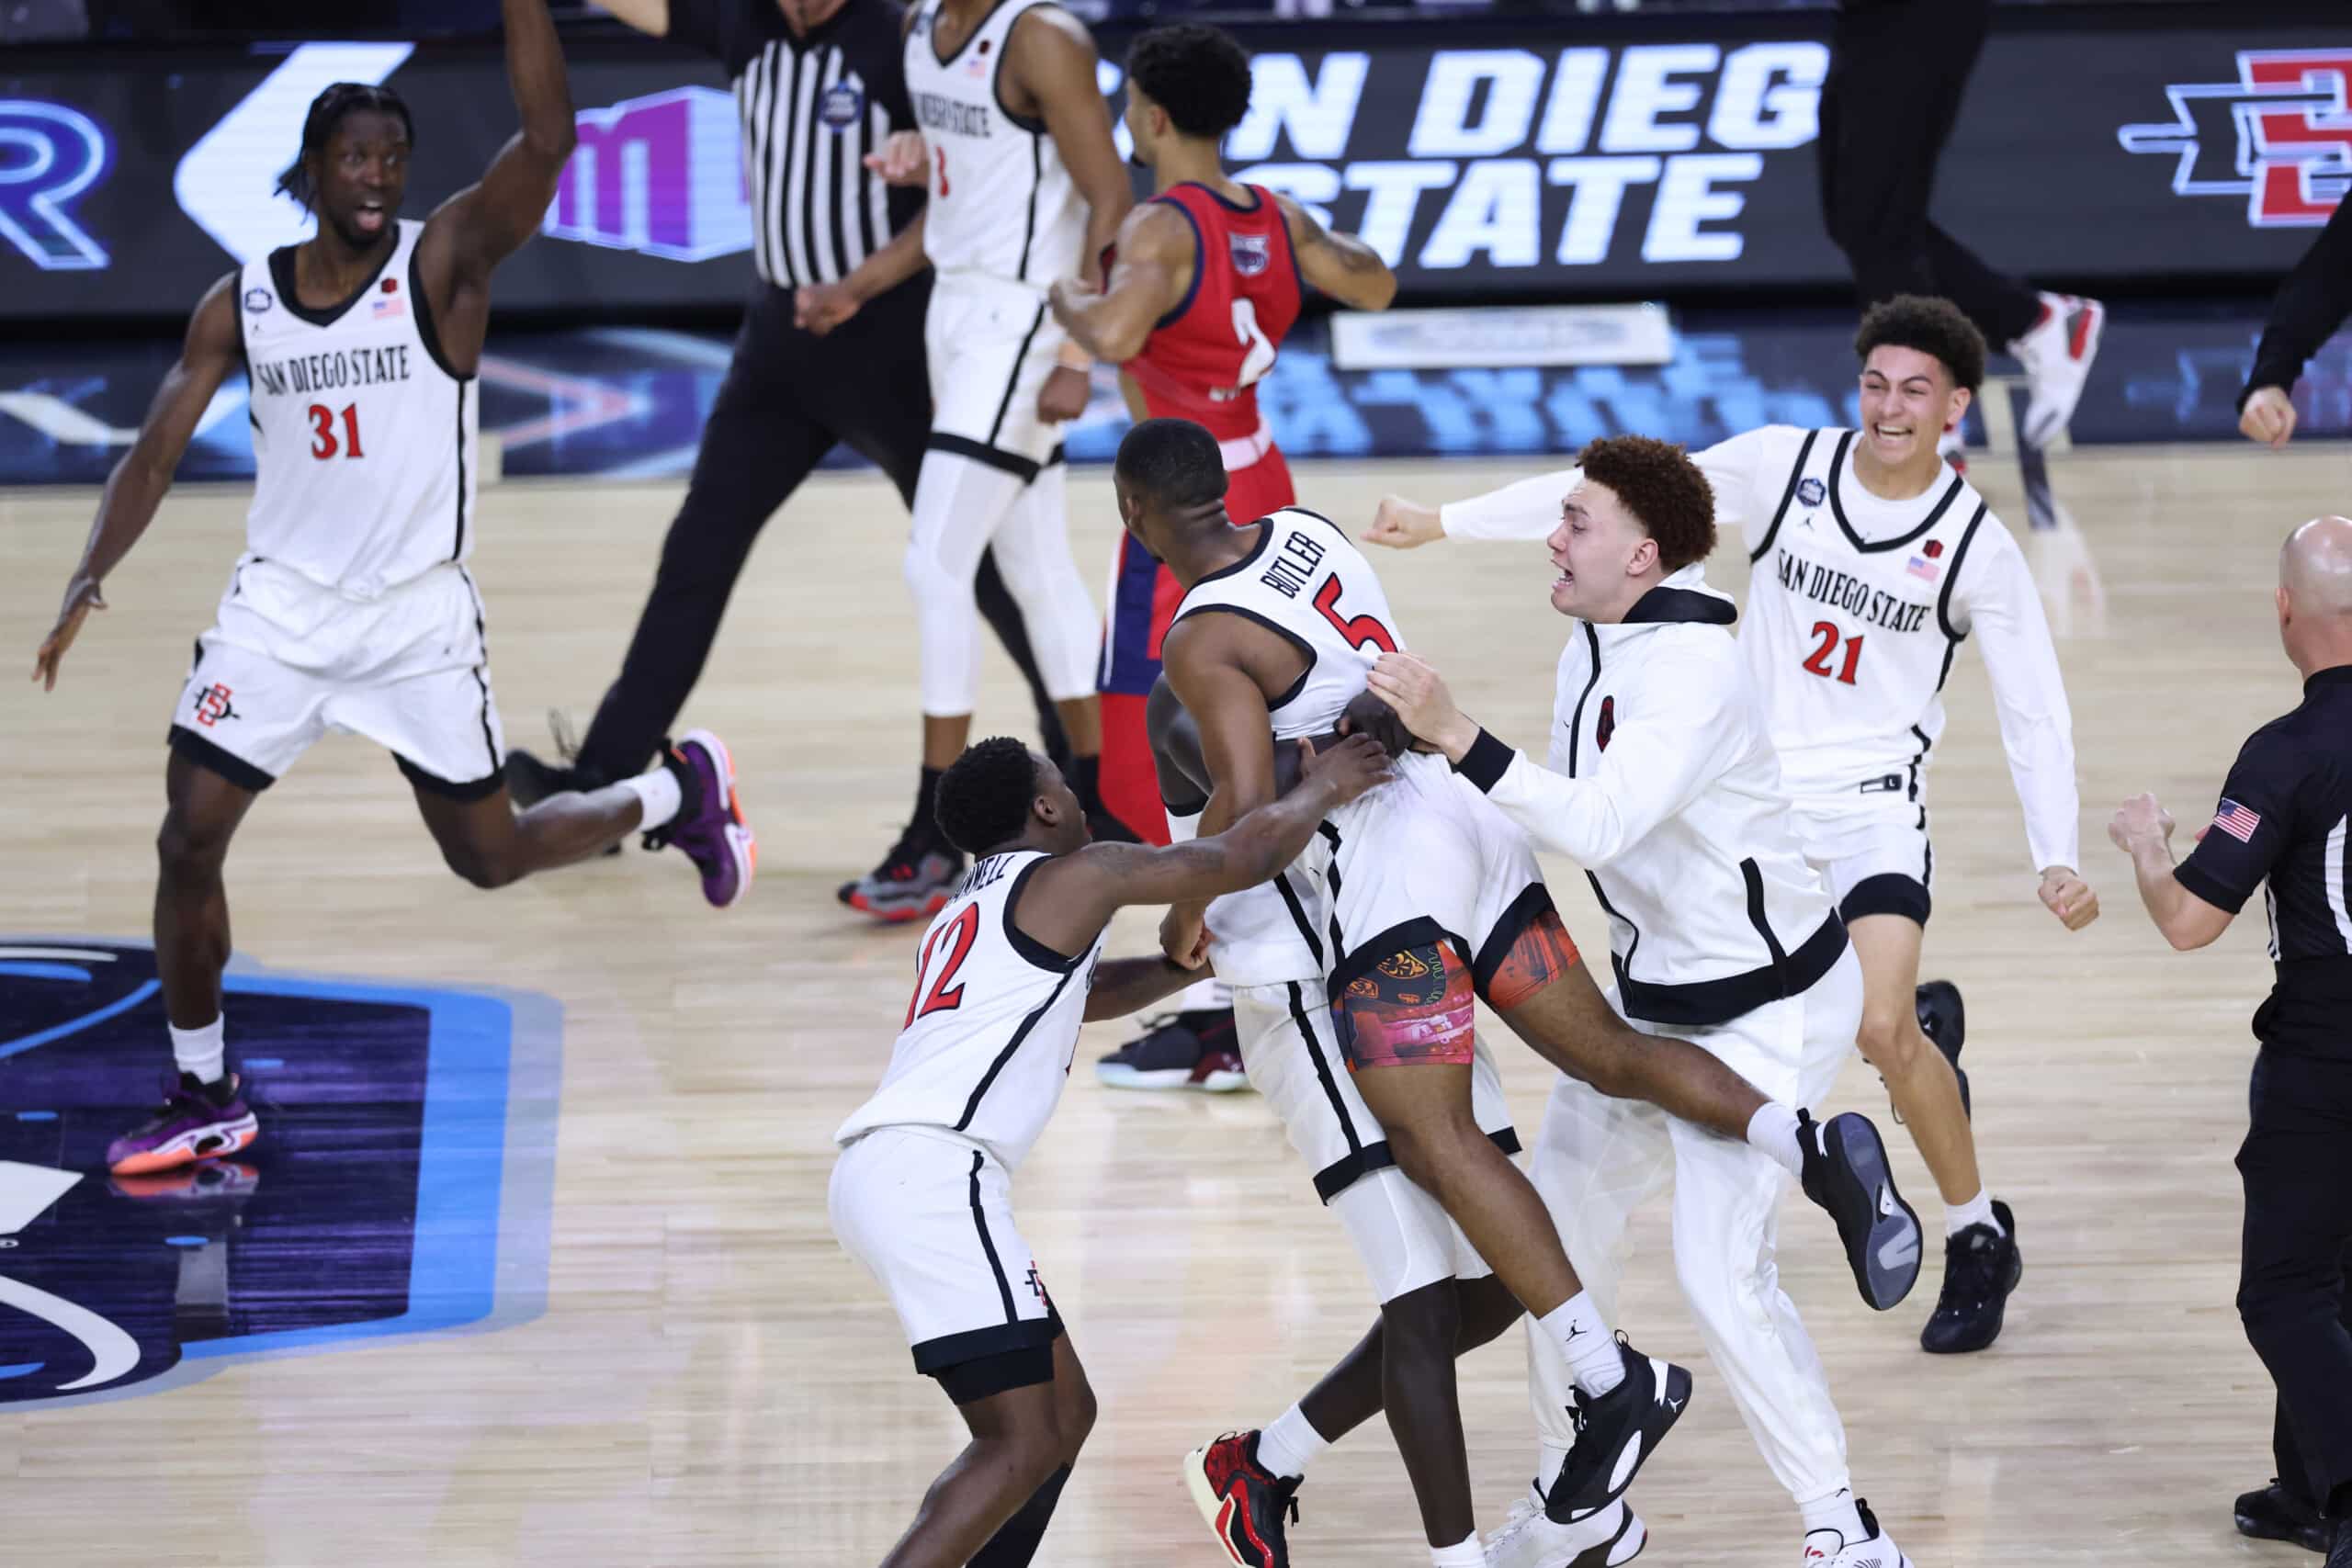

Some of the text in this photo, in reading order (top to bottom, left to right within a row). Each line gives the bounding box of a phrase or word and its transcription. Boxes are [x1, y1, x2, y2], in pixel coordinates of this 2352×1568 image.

[1406, 42, 1830, 159] DIEG
[256, 344, 411, 396] SAN DIEGO STATE
[308, 400, 365, 461] 31
[1260, 530, 1327, 600] BUTLER
[1778, 547, 1932, 633] SAN DIEGO STATE
[1311, 570, 1399, 654] 5
[1802, 620, 1865, 686] 21
[902, 901, 980, 1032] 12
